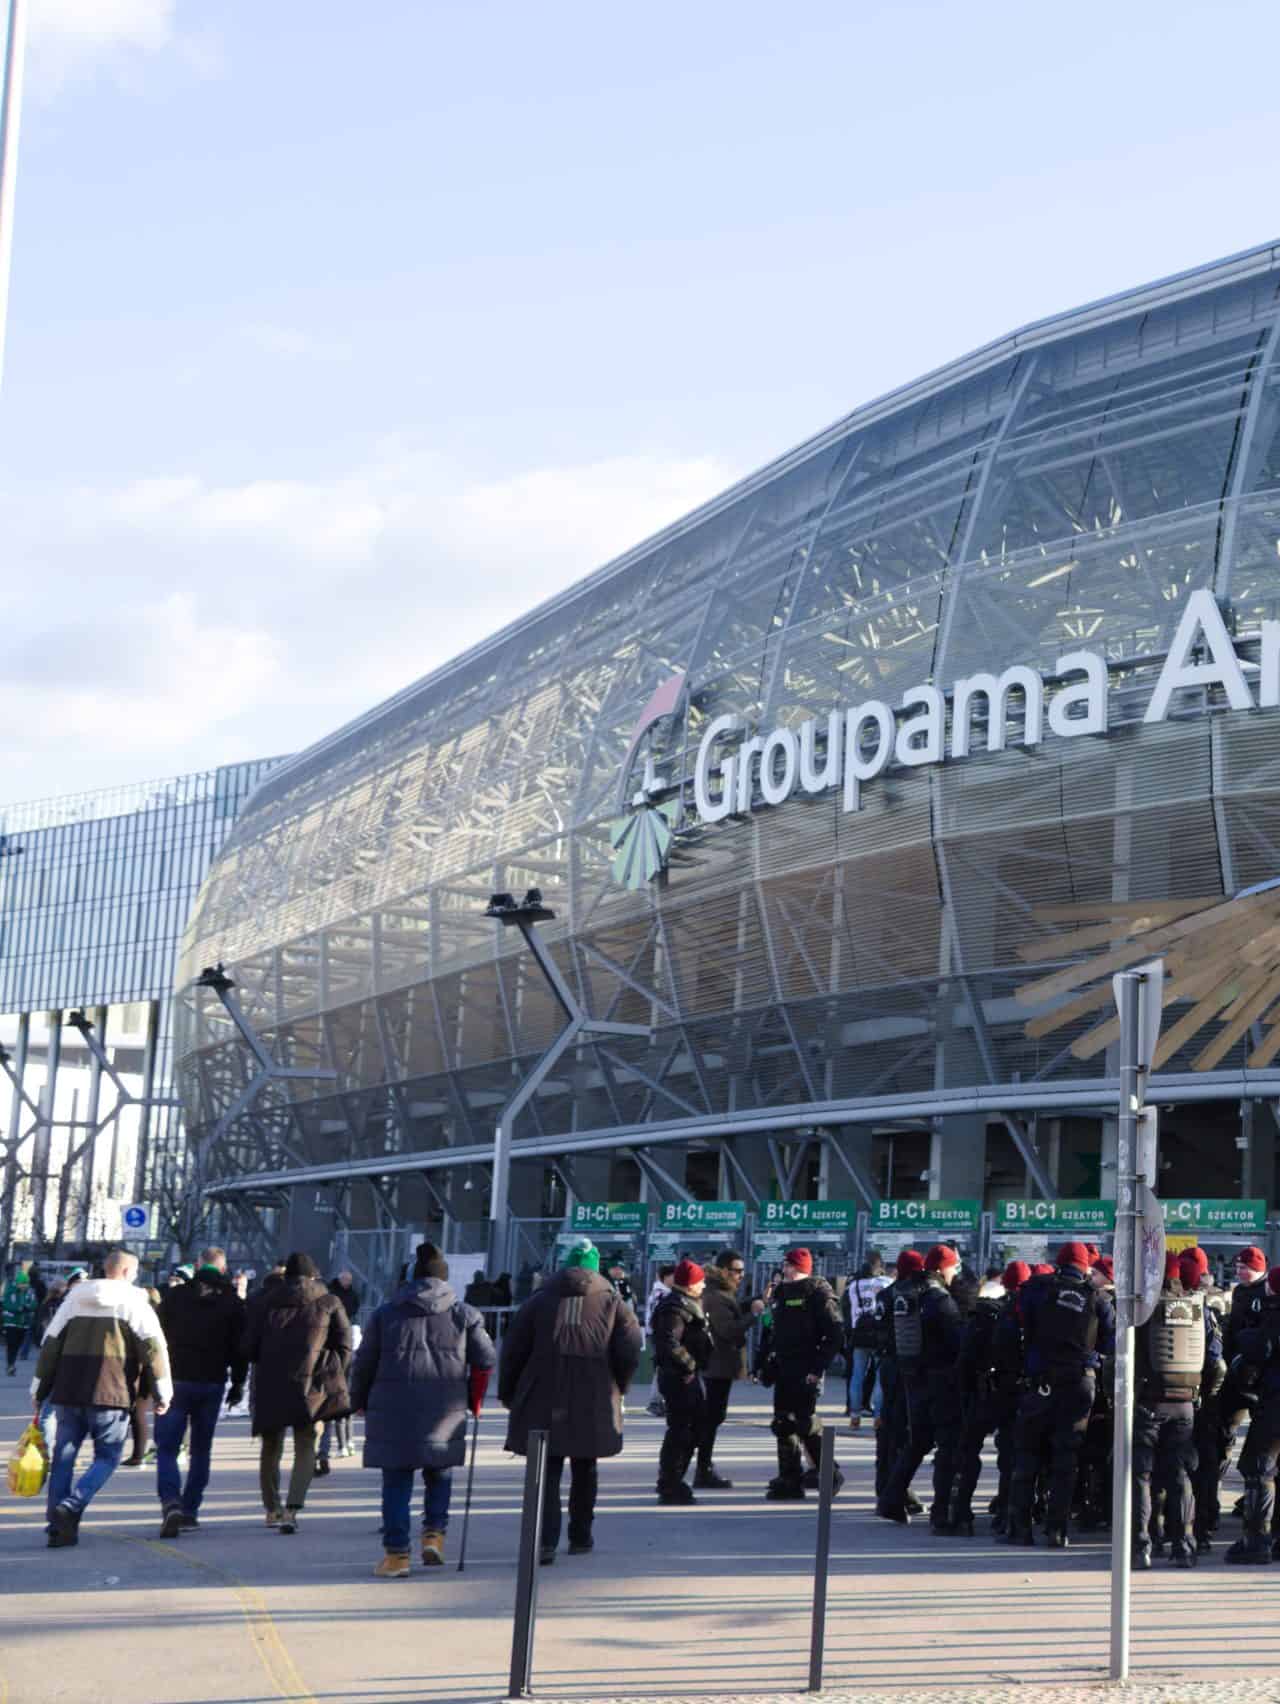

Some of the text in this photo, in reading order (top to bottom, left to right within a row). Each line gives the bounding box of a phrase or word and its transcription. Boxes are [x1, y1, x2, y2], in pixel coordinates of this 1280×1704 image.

[694, 650, 1110, 824] Groupama
[576, 1205, 610, 1221] B1-C1
[666, 1204, 704, 1220] B1-C1
[766, 1203, 809, 1220] B1-C1
[879, 1202, 927, 1220] B1-C1
[1005, 1202, 1057, 1220] B1-C1
[1160, 1201, 1202, 1220] 1-C1
